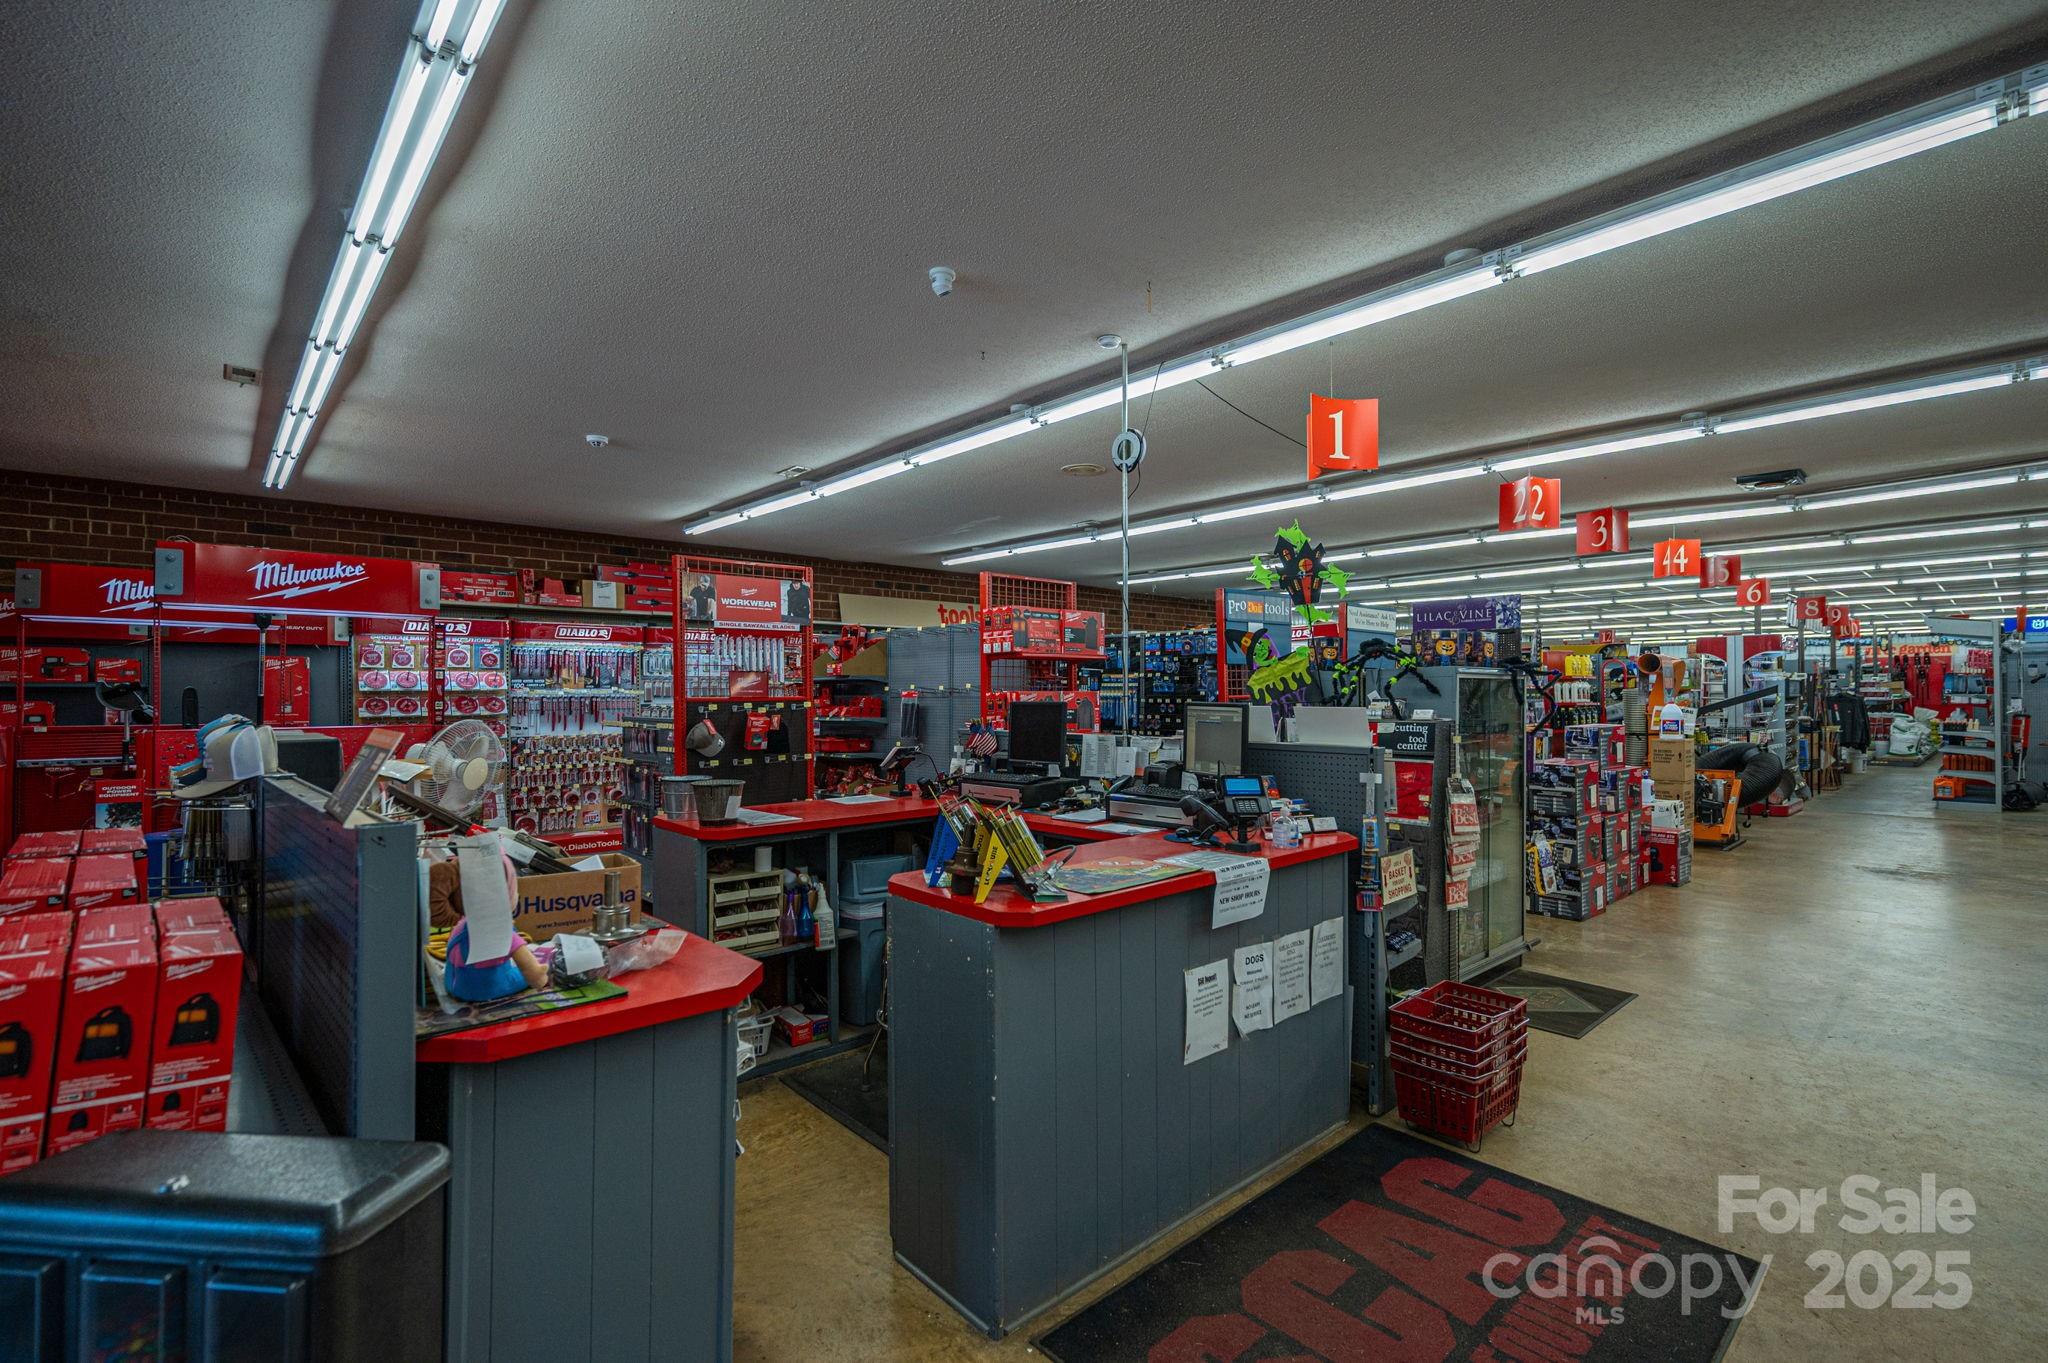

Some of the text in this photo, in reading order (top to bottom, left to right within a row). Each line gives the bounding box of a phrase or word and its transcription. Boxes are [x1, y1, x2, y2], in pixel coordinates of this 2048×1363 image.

[1329, 410, 1350, 459] 1
[1591, 516, 1607, 547] 3
[247, 561, 366, 591] Milwaukee
[1718, 560, 1729, 582] 5
[1746, 581, 1762, 603] 6
[721, 598, 777, 608] WORKWEAR
[1265, 601, 1290, 616] tools
[1805, 600, 1819, 616] 8
[1416, 611, 1451, 622] LILAC
[1460, 609, 1492, 619] VINE
[1831, 608, 1841, 624] 9
[407, 621, 454, 633] DIAO
[559, 627, 598, 637] DIABLO
[1395, 724, 1429, 735] cutting
[1408, 731, 1428, 743] tool
[1397, 742, 1428, 751] center
[1388, 866, 1407, 880] BASKET
[1388, 884, 1412, 900] SHOPPING
[524, 889, 636, 915] Husqvana
[1245, 954, 1264, 966] DOGS
